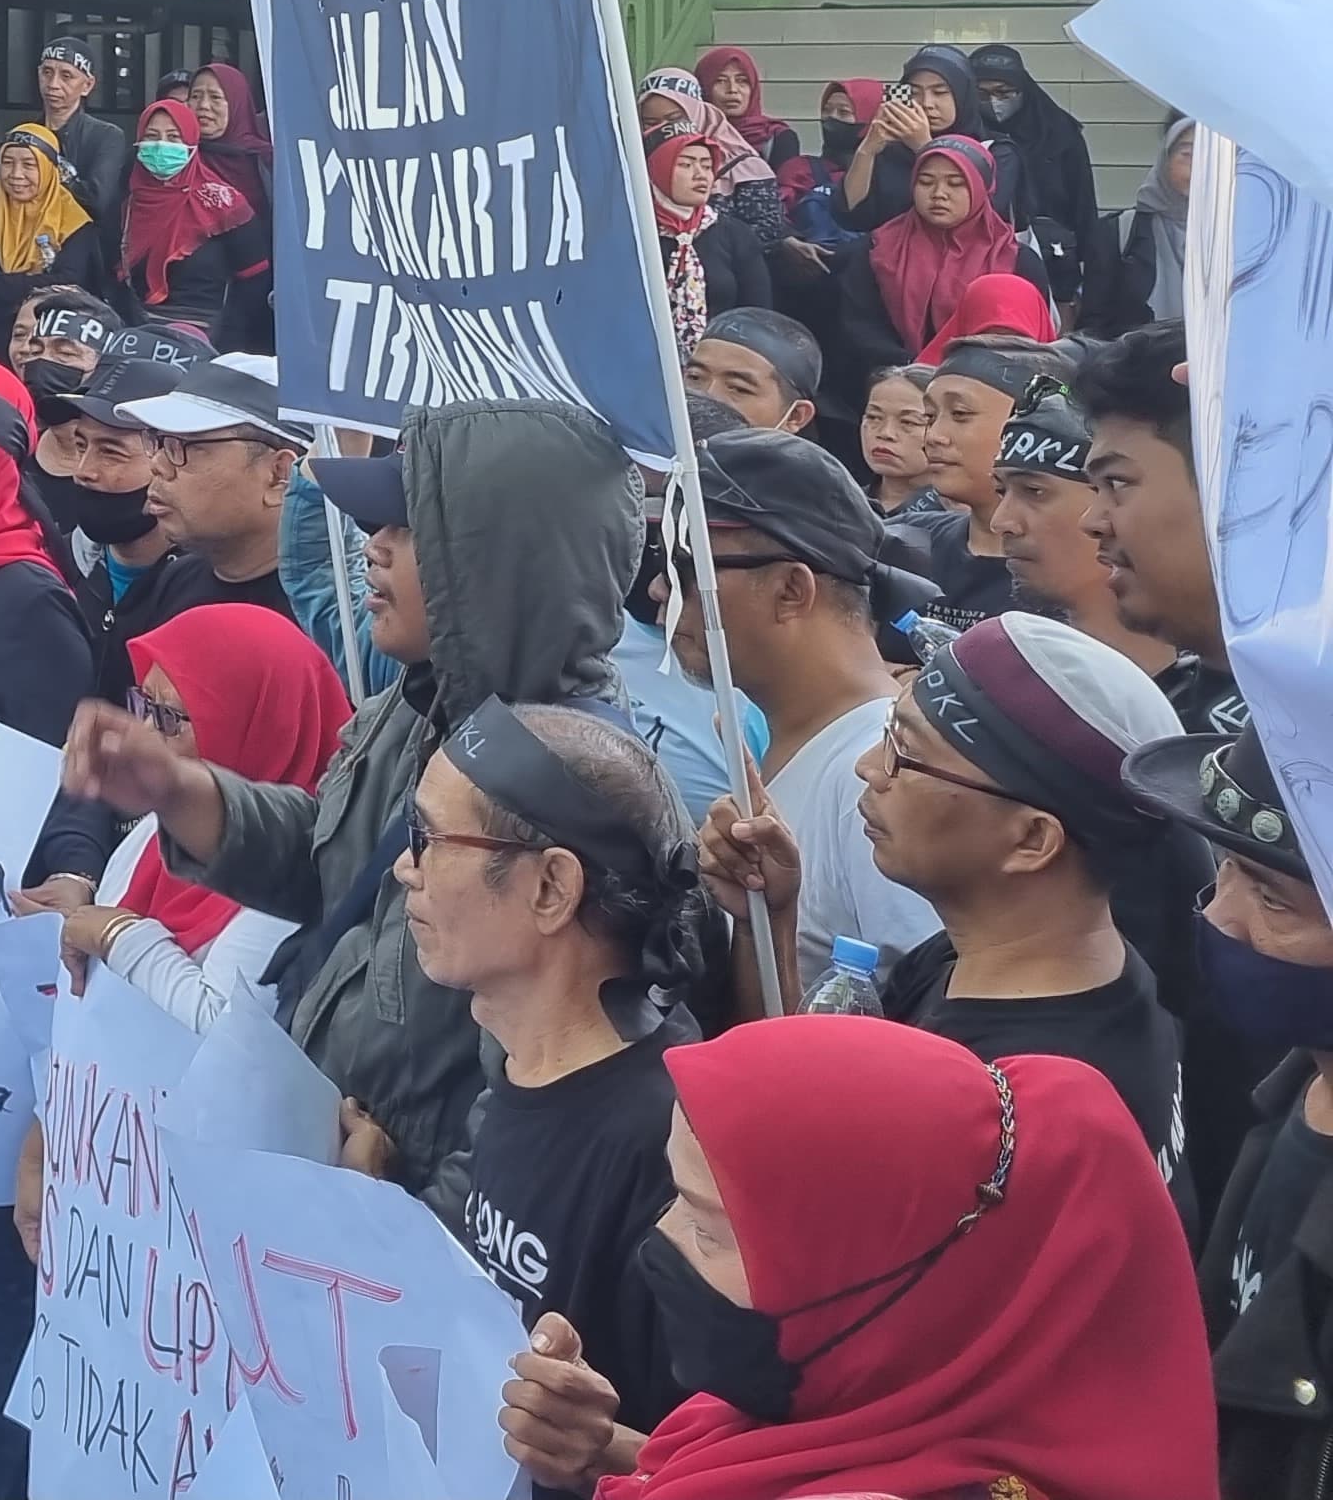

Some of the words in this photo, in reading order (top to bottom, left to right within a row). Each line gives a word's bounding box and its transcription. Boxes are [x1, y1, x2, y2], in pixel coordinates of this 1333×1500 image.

[1008, 433, 1081, 473] PKL
[64, 1205, 133, 1327] DAN
[58, 1332, 160, 1493] TIDAK
